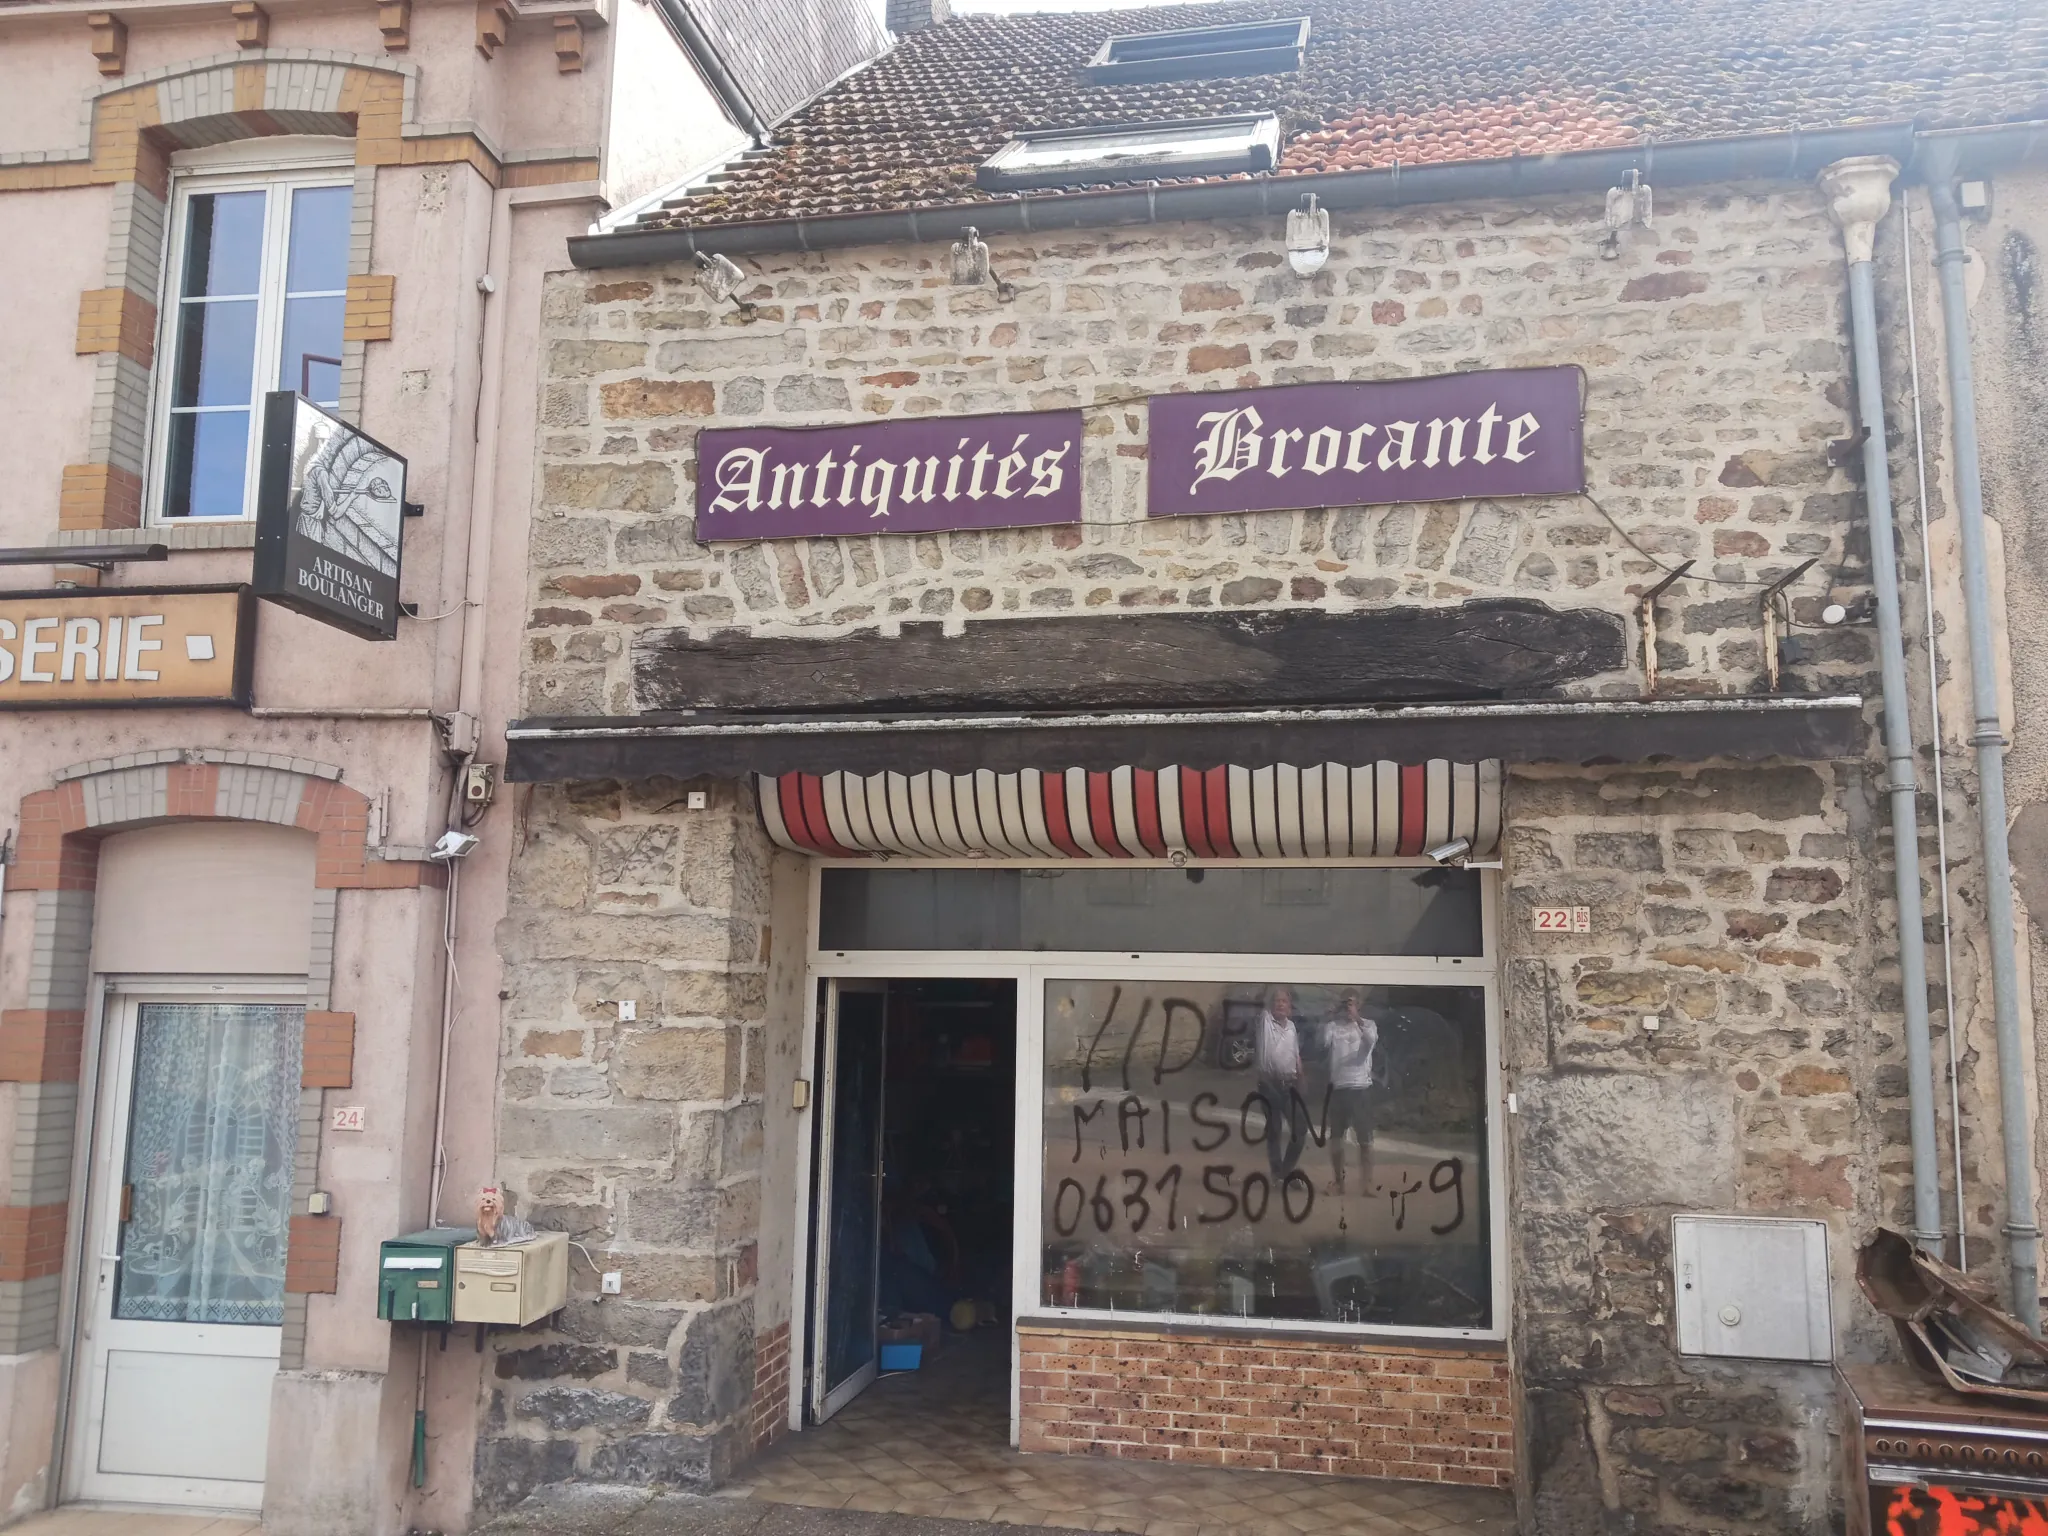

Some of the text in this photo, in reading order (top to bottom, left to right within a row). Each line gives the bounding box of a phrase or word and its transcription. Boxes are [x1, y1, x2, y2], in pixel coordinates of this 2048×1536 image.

[708, 401, 1541, 518] Antiquités Brocante
[297, 567, 385, 620] BOULANGER
[312, 556, 373, 596] ARTISAN
[1538, 911, 1588, 928] 22 BIS
[336, 1111, 359, 1127] 24
